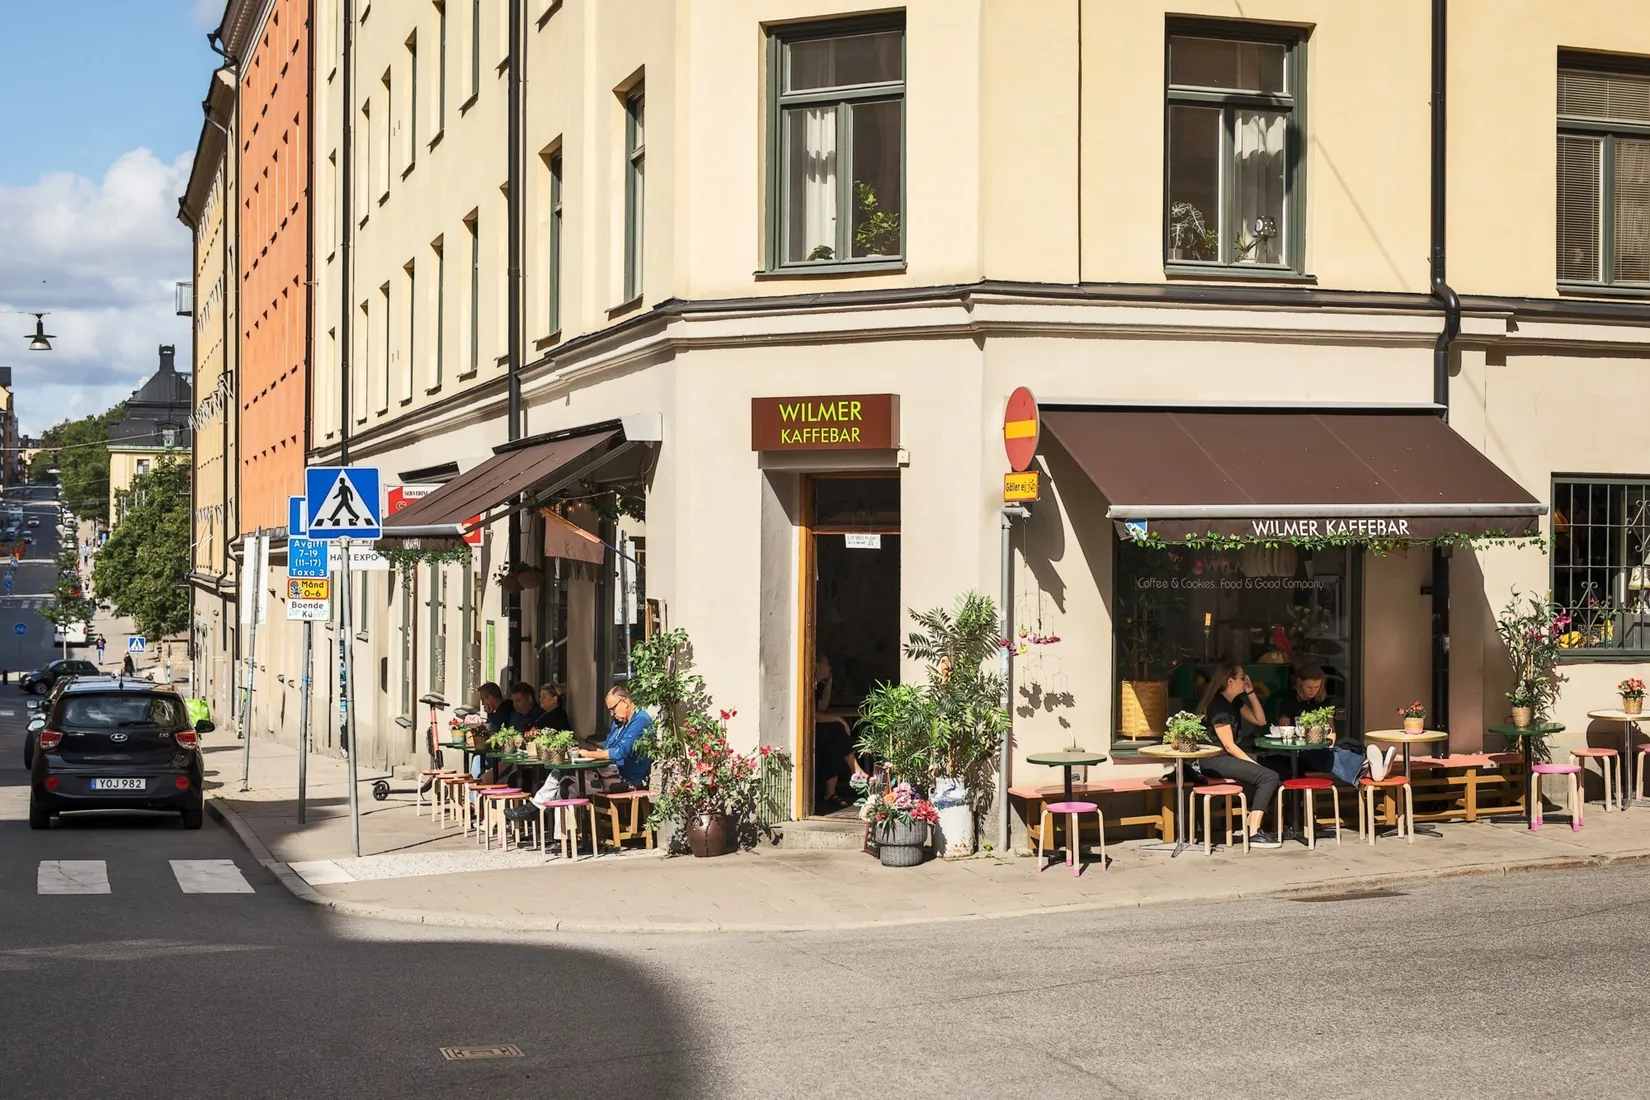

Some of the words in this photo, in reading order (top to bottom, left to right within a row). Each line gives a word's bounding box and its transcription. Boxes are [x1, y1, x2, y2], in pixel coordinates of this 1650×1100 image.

[779, 401, 862, 422] WILMER
[781, 427, 860, 444] KAFFEBAR
[1252, 520, 1318, 537] WILMER
[1326, 519, 1410, 536] KAFFEBAR
[294, 540, 323, 549] Avgift
[295, 559, 321, 567] (11-17)
[1138, 578, 1168, 589] Coffee
[1171, 578, 1179, 588] &
[1181, 578, 1217, 589] Cookies.
[1220, 578, 1242, 589] Food
[1245, 578, 1252, 589] &
[1254, 578, 1281, 589] Good
[1282, 578, 1326, 591] Company.
[100, 780, 119, 788] YOJ
[122, 779, 142, 788] 982
